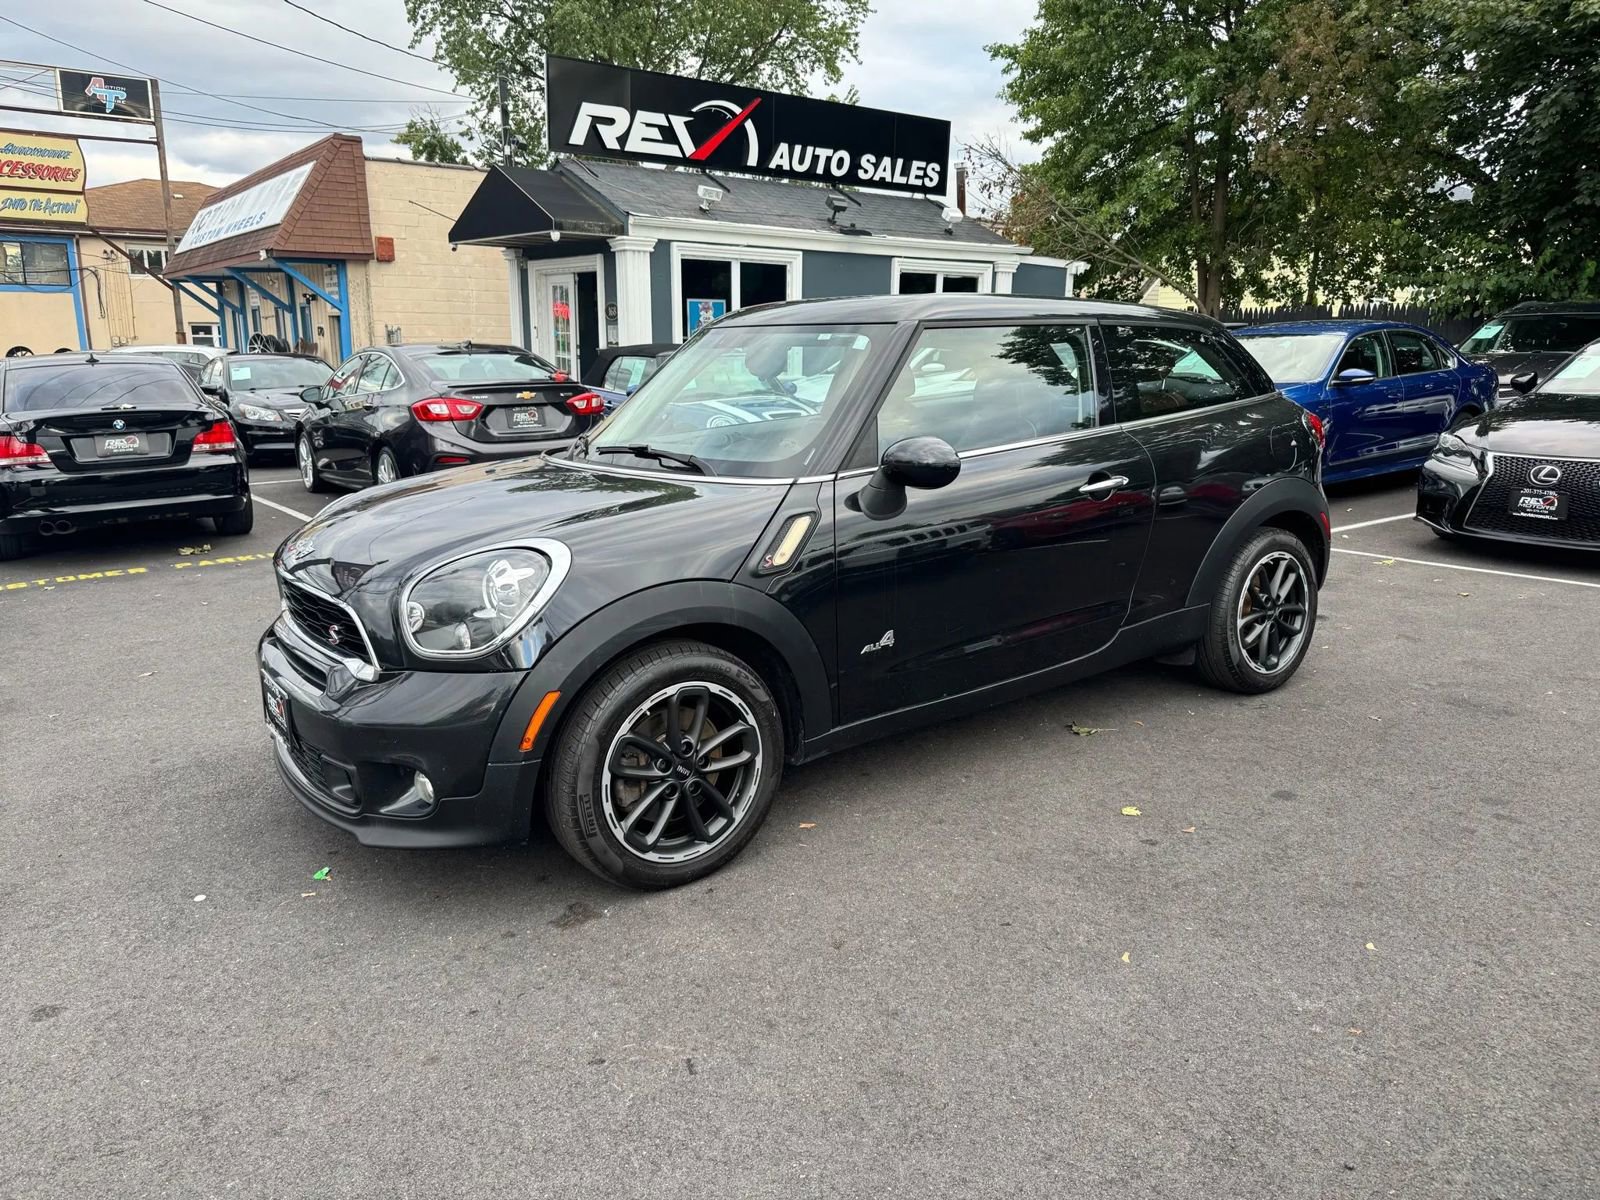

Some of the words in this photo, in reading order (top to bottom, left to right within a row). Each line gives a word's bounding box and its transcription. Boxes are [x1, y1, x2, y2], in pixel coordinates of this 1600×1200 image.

[568, 97, 762, 167] REV
[769, 143, 850, 177] AUTO
[857, 154, 941, 188] SALES
[0, 567, 149, 591] STOMER
[580, 792, 599, 839] PIRELLI
